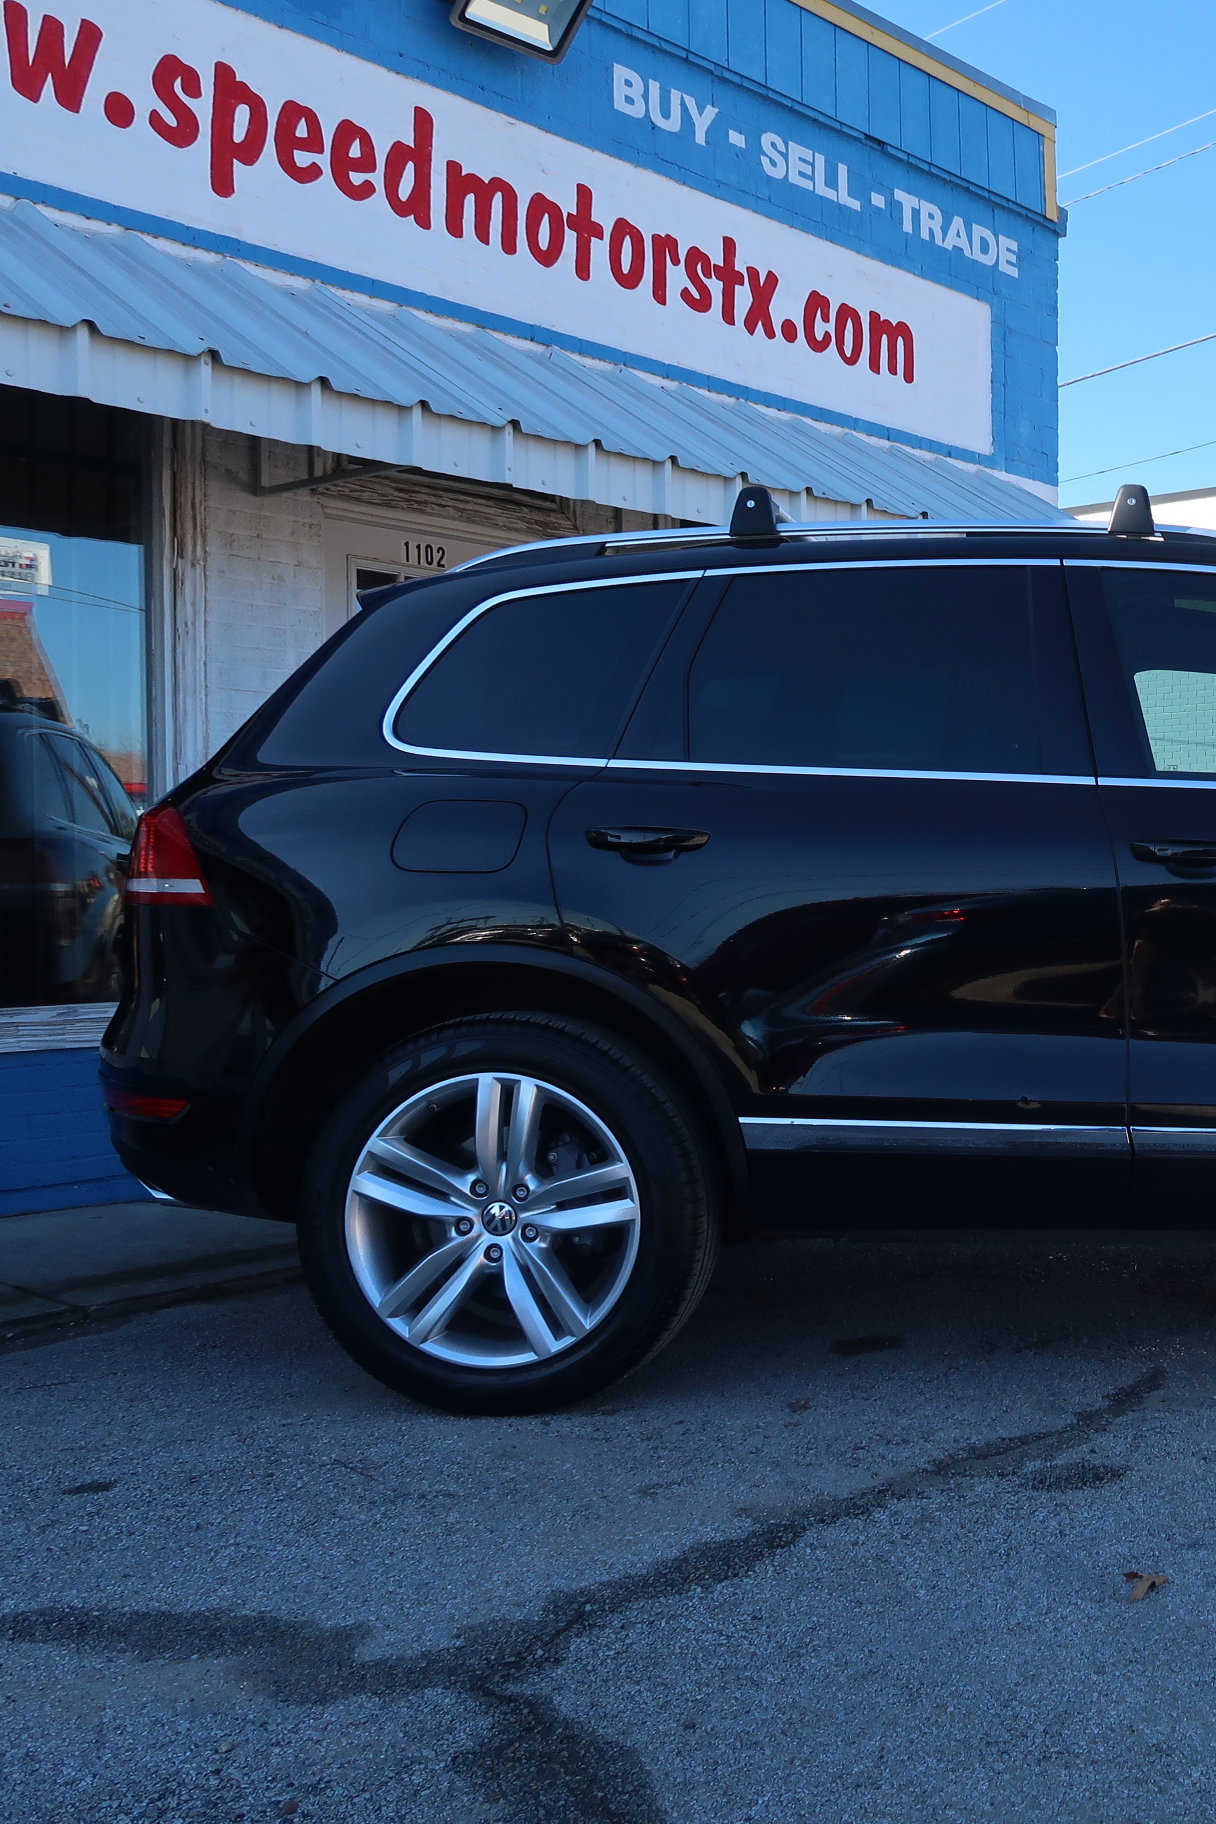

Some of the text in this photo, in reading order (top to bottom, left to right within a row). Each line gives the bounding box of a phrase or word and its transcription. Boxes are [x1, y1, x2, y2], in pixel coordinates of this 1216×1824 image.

[3, 0, 914, 384] w.speedmotorstx.com
[613, 63, 719, 146] BUY
[760, 132, 861, 211] SELL
[894, 187, 1019, 278] TRADE
[403, 540, 446, 568] 1102
